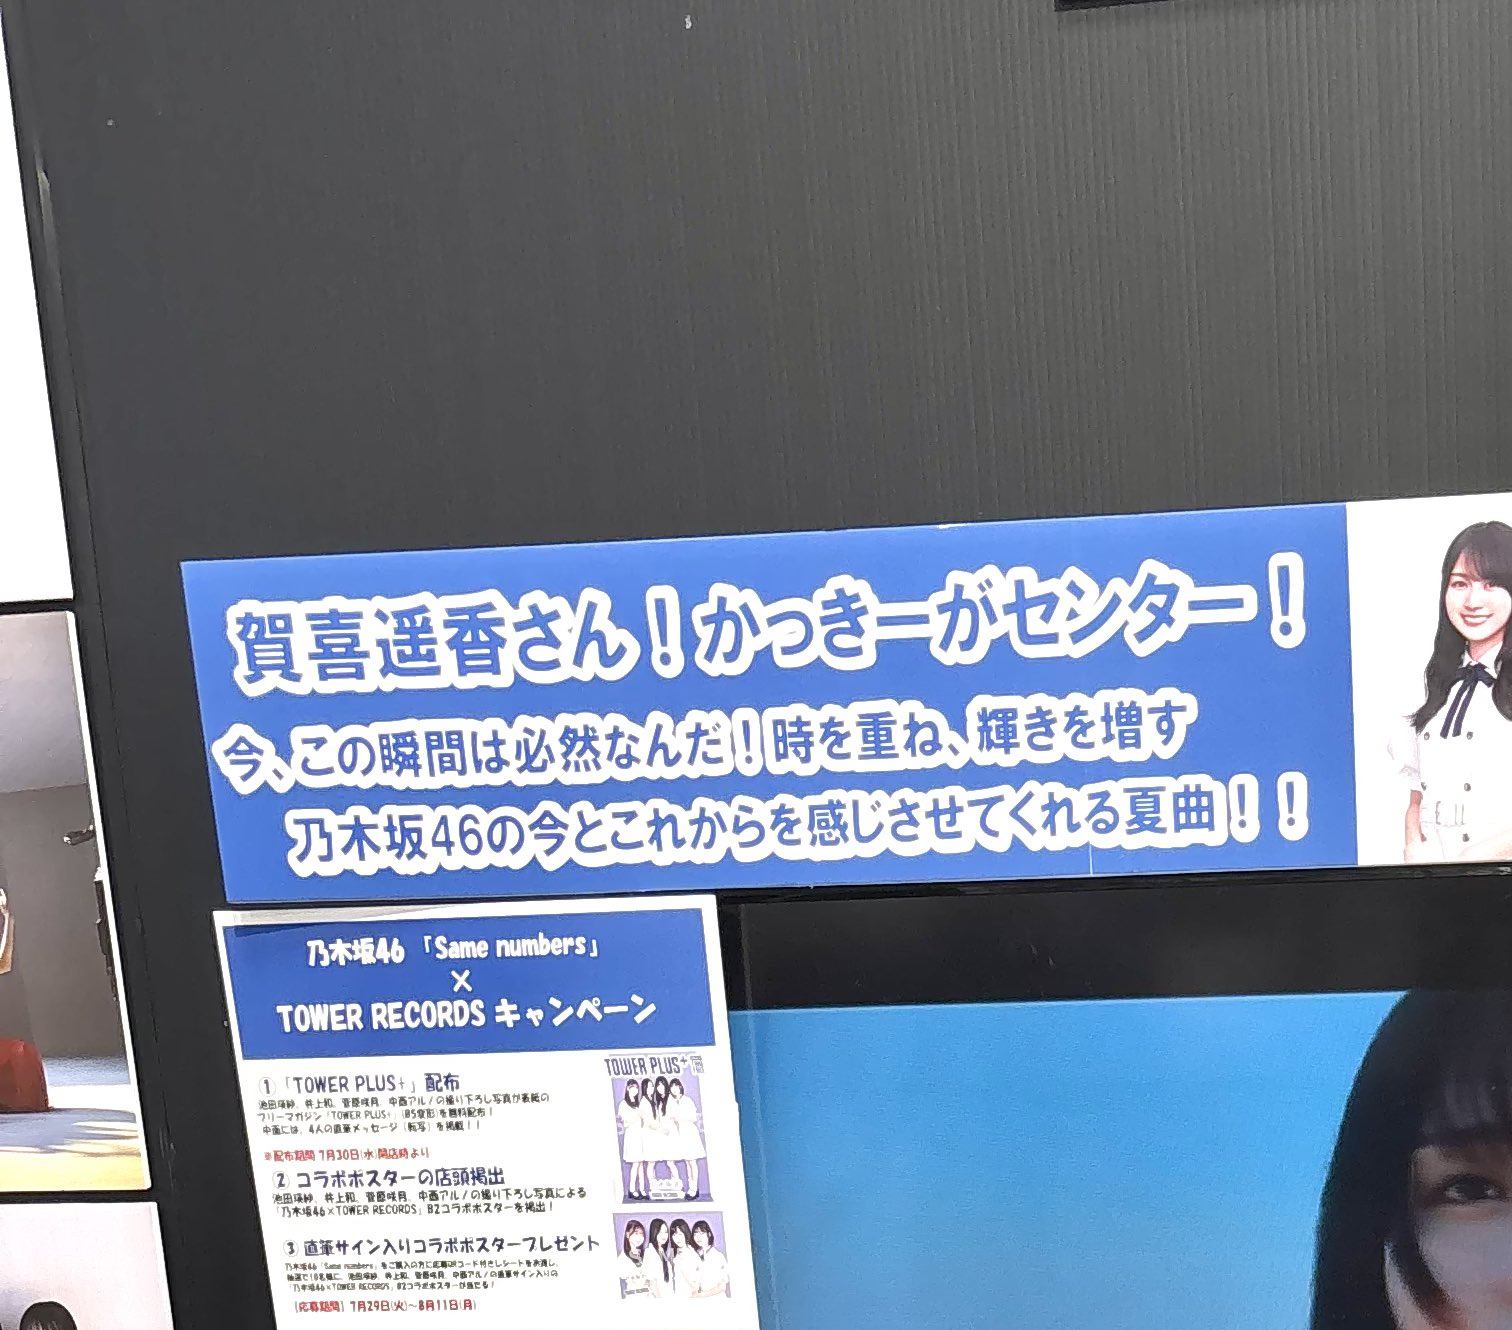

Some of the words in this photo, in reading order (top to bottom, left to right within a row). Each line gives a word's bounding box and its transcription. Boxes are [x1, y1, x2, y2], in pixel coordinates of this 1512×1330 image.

[230, 556, 1300, 693] 賀喜遥香さん！かっきーがセンター！
[216, 694, 1193, 790] 今、この瞬間は必然なんだ！時を重ね、輝きを増す
[288, 777, 1306, 873] 乃木坂46の今とこれからを感じさせてくれる夏曲！！
[306, 937, 406, 968] 乃木坂46
[275, 1001, 364, 1034] TOWER
[370, 997, 486, 1032] RECORDS
[493, 992, 658, 1029] キャンペーン
[425, 1071, 460, 1093] 配布
[604, 1057, 648, 1076] TOWER
